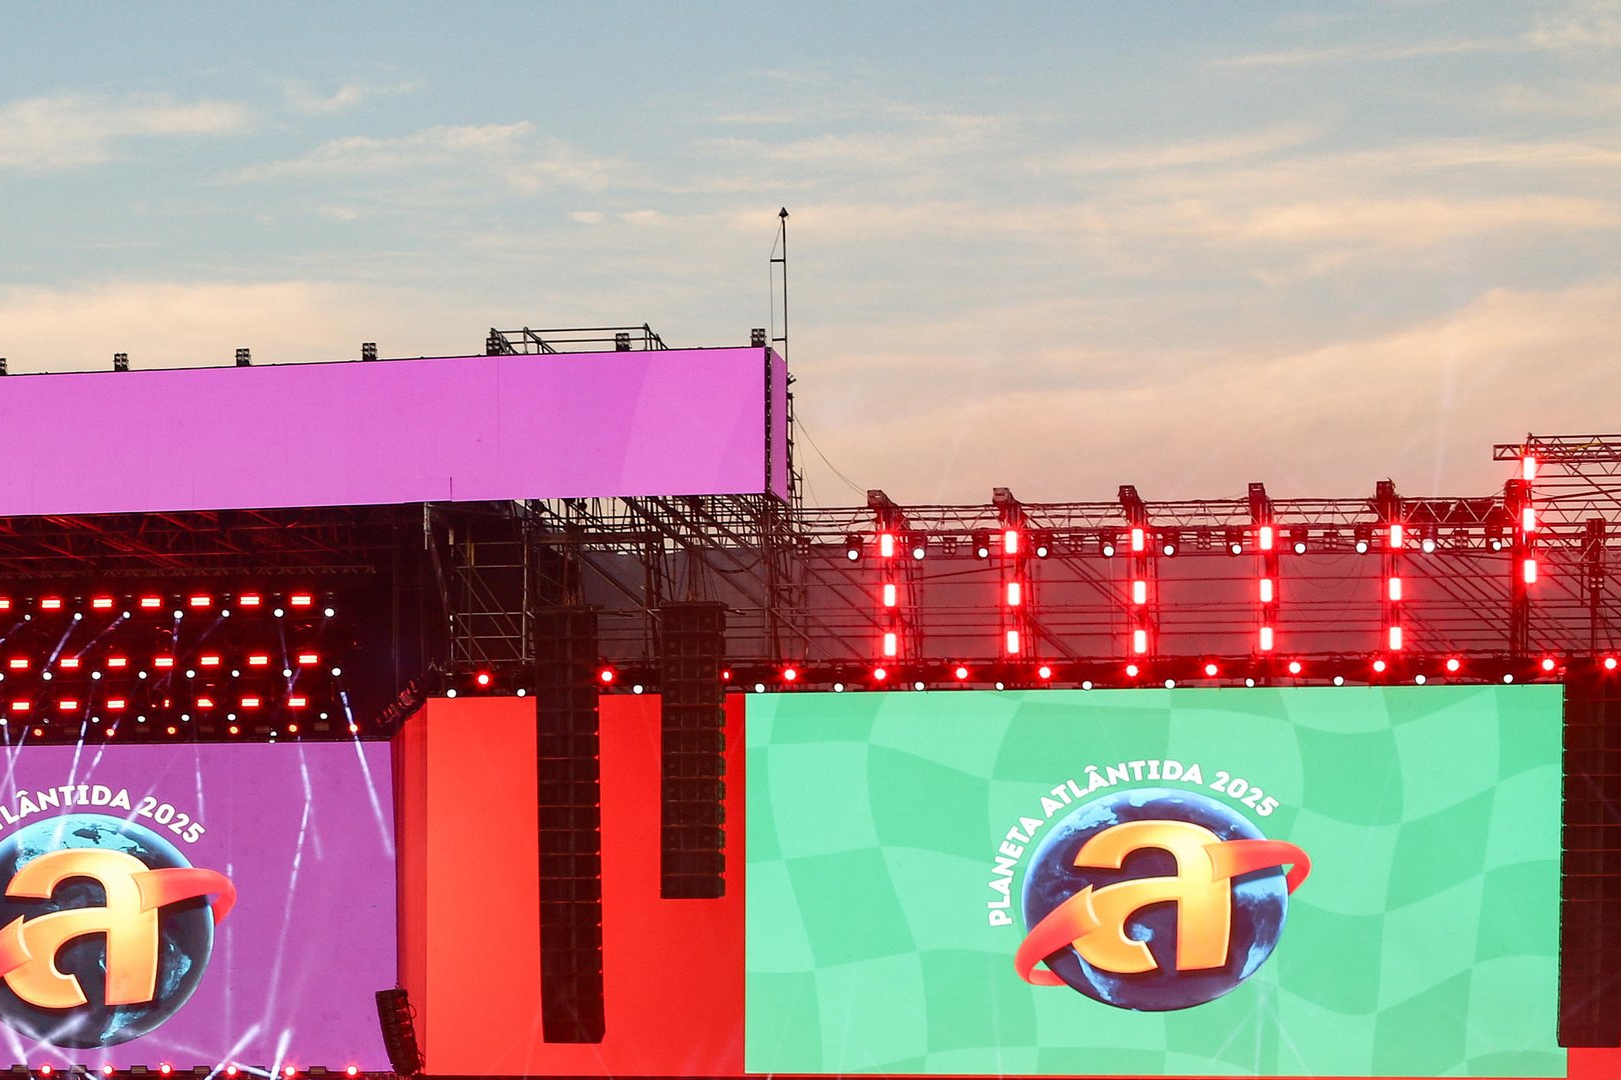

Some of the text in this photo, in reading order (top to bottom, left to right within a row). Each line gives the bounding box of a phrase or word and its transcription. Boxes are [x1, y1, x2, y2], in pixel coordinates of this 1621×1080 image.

[137, 795, 207, 845] 2025
[986, 759, 1281, 928] PLANETA ATLÂNTIDA 2025
